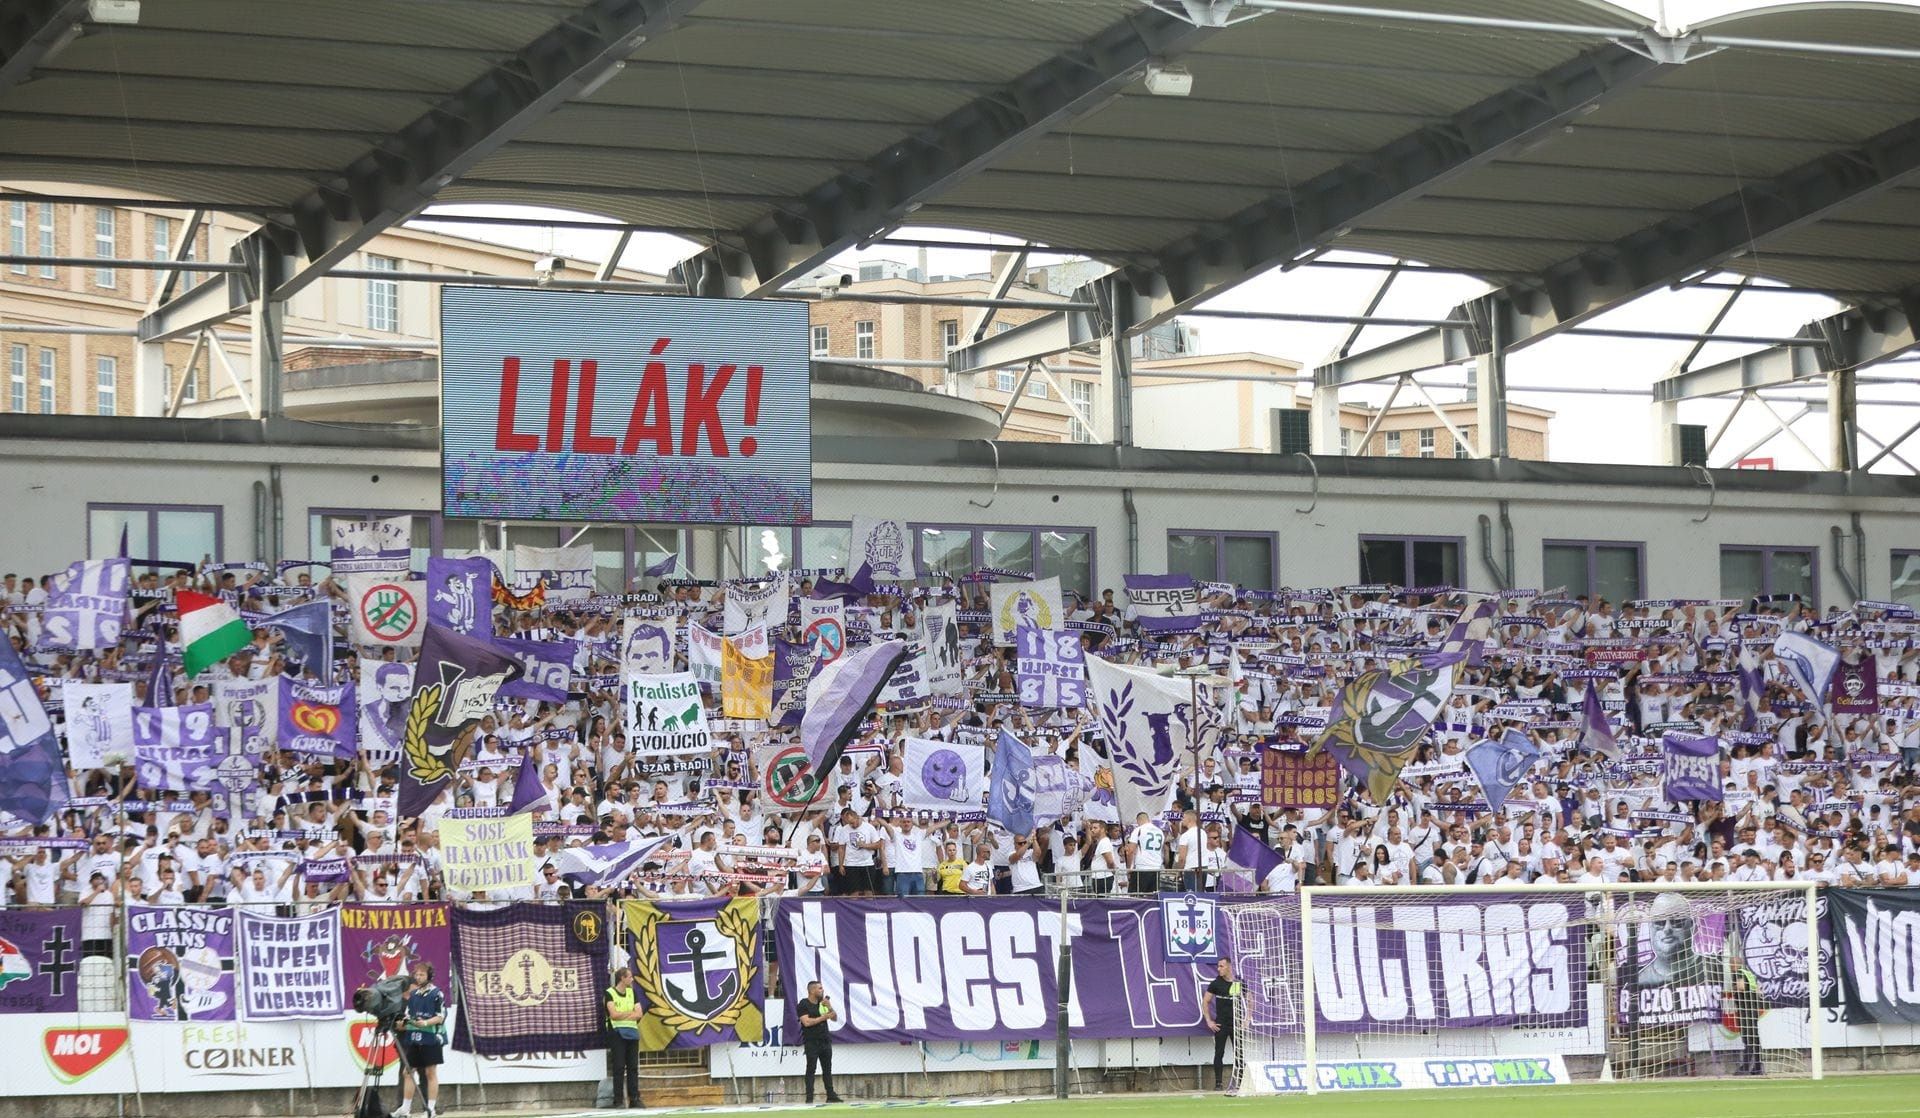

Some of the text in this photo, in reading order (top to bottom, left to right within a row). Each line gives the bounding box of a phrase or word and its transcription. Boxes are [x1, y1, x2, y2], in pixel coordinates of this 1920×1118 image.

[495, 337, 764, 457] LILÁK!
[336, 520, 403, 539] ÚJPEST
[132, 589, 167, 598] FRADI
[627, 594, 658, 602] FRADI
[1131, 589, 1196, 602] ULTRAS
[812, 605, 839, 614] STOP
[1618, 620, 1669, 629] SZAR FRADI
[1058, 635, 1079, 659] 8
[1022, 660, 1079, 678] ÚJPEST
[632, 681, 697, 700] fradista
[1021, 679, 1042, 702] 8
[1061, 682, 1080, 705] 5
[186, 711, 209, 740] 9
[632, 729, 707, 751] EVOLÚCIÓ
[642, 763, 672, 774] SZAR
[1264, 770, 1295, 787] UTE
[1264, 787, 1295, 805] UTE
[465, 821, 506, 841] SOSE
[1146, 832, 1163, 851] 23
[445, 841, 529, 864] HAGYUNK
[449, 862, 528, 886] EGYEDÜL
[131, 911, 232, 935] CLASSIC
[248, 919, 330, 941] CSAK AZ
[1174, 919, 1189, 929] 18
[155, 931, 205, 949] FANS
[790, 901, 1086, 1031] ÚJPEST
[1311, 903, 1569, 1021] ULTRAS
[253, 972, 269, 987] AD
[183, 1026, 248, 1044] FRESH
[52, 1034, 102, 1056] MOL
[185, 1047, 296, 1070] CORNER
